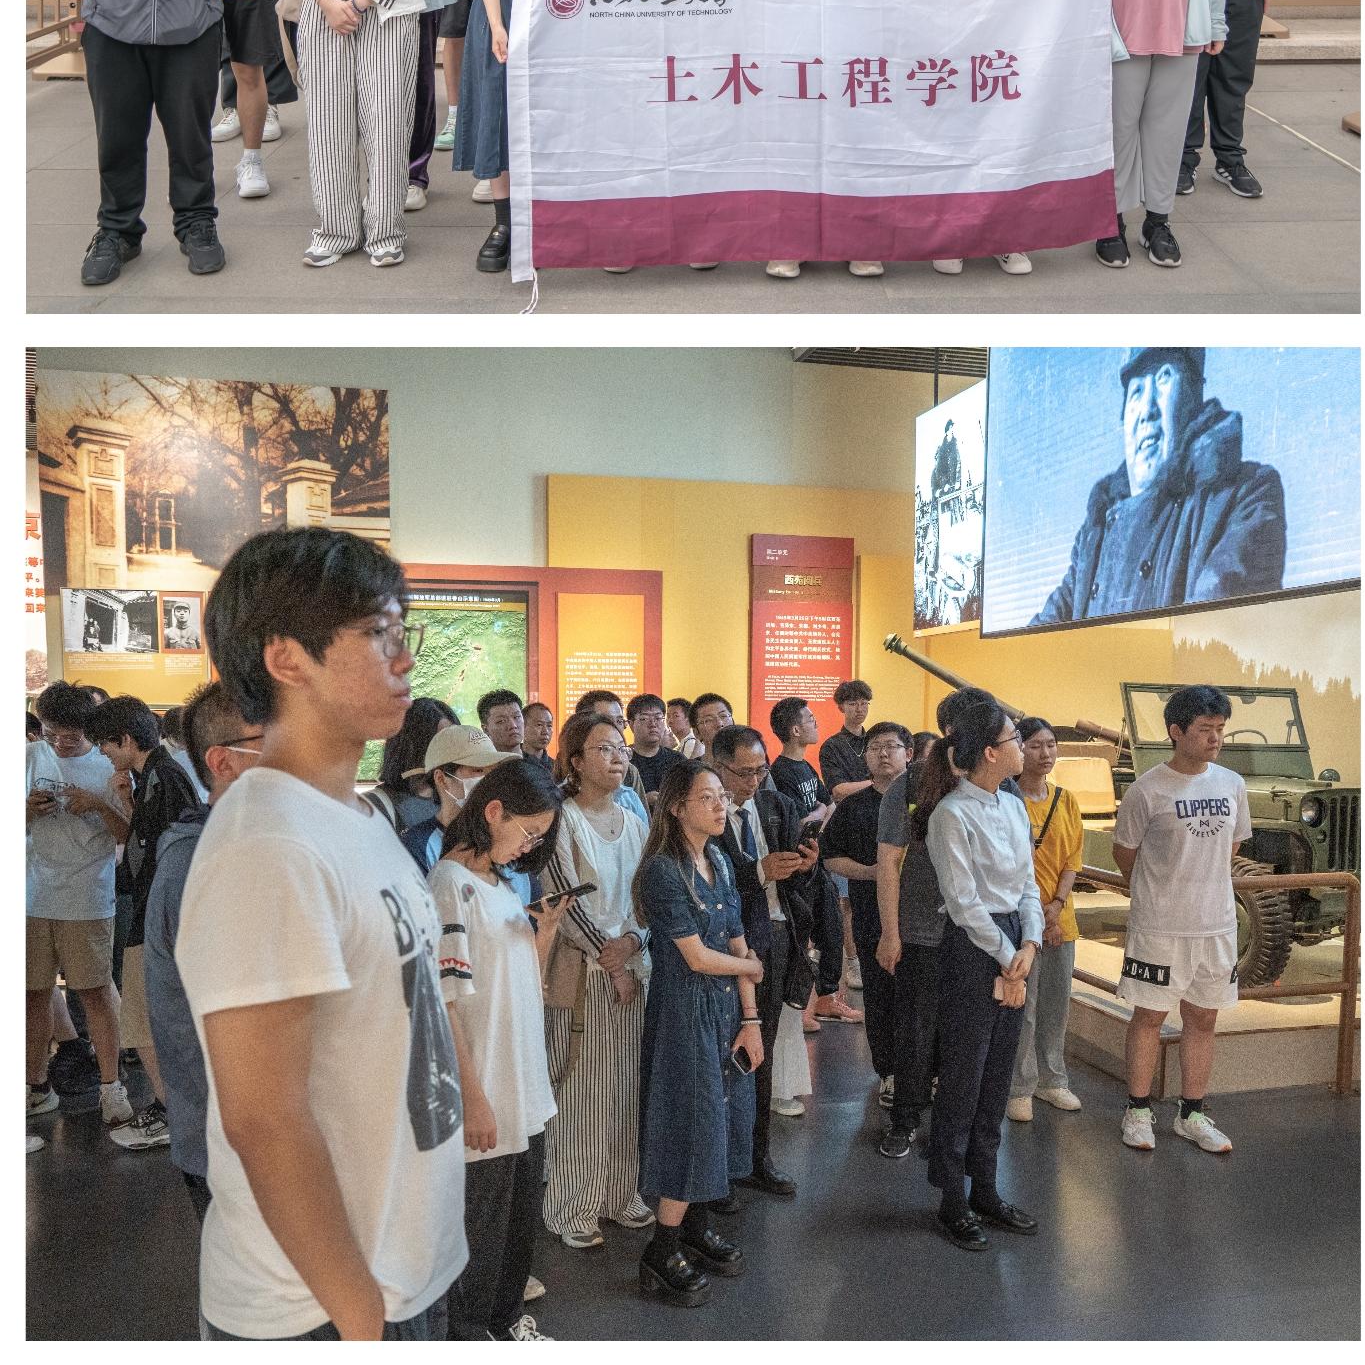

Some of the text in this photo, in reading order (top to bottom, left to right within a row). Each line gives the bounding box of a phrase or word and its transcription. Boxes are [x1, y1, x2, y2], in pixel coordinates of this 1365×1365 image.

[637, 10, 675, 18] UNIVERSITY
[676, 9, 687, 17] OF
[687, 8, 732, 16] TECHNOLOGY
[645, 49, 1023, 108] 土木工程学院
[1175, 797, 1231, 819] CLIPPERS
[1185, 819, 1225, 838] BASKETBALL
